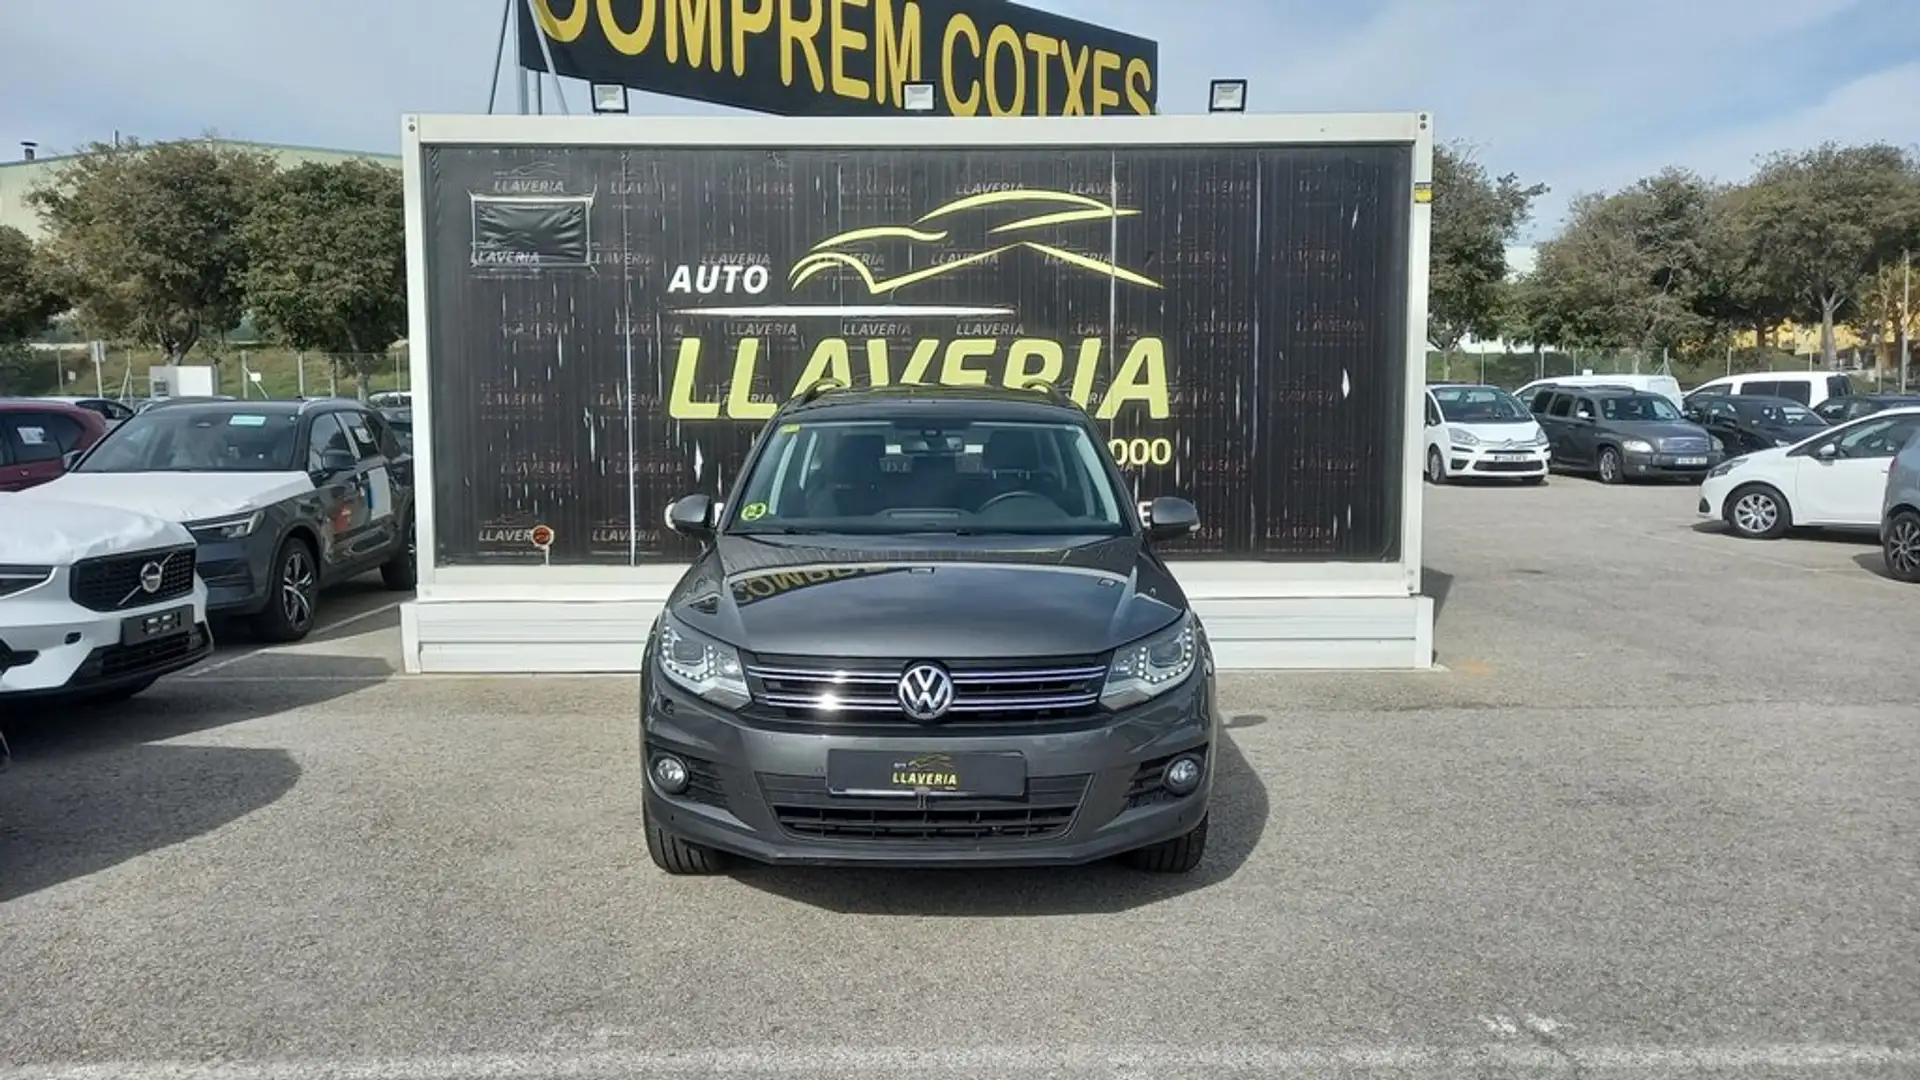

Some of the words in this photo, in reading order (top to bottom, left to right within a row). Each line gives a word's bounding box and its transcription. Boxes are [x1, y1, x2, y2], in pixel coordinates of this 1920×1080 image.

[942, 13, 1152, 117] COTXES
[494, 180, 564, 192] LLAVERIA
[667, 265, 769, 295] AUTO
[730, 322, 798, 336] LLAVERIA
[843, 323, 912, 335] LLAVERIA
[956, 323, 1025, 335] LLAVERIA
[668, 337, 1170, 420] LLAVERIA
[478, 529, 533, 542] LLAVER
[892, 772, 957, 786] LLAVERIA
